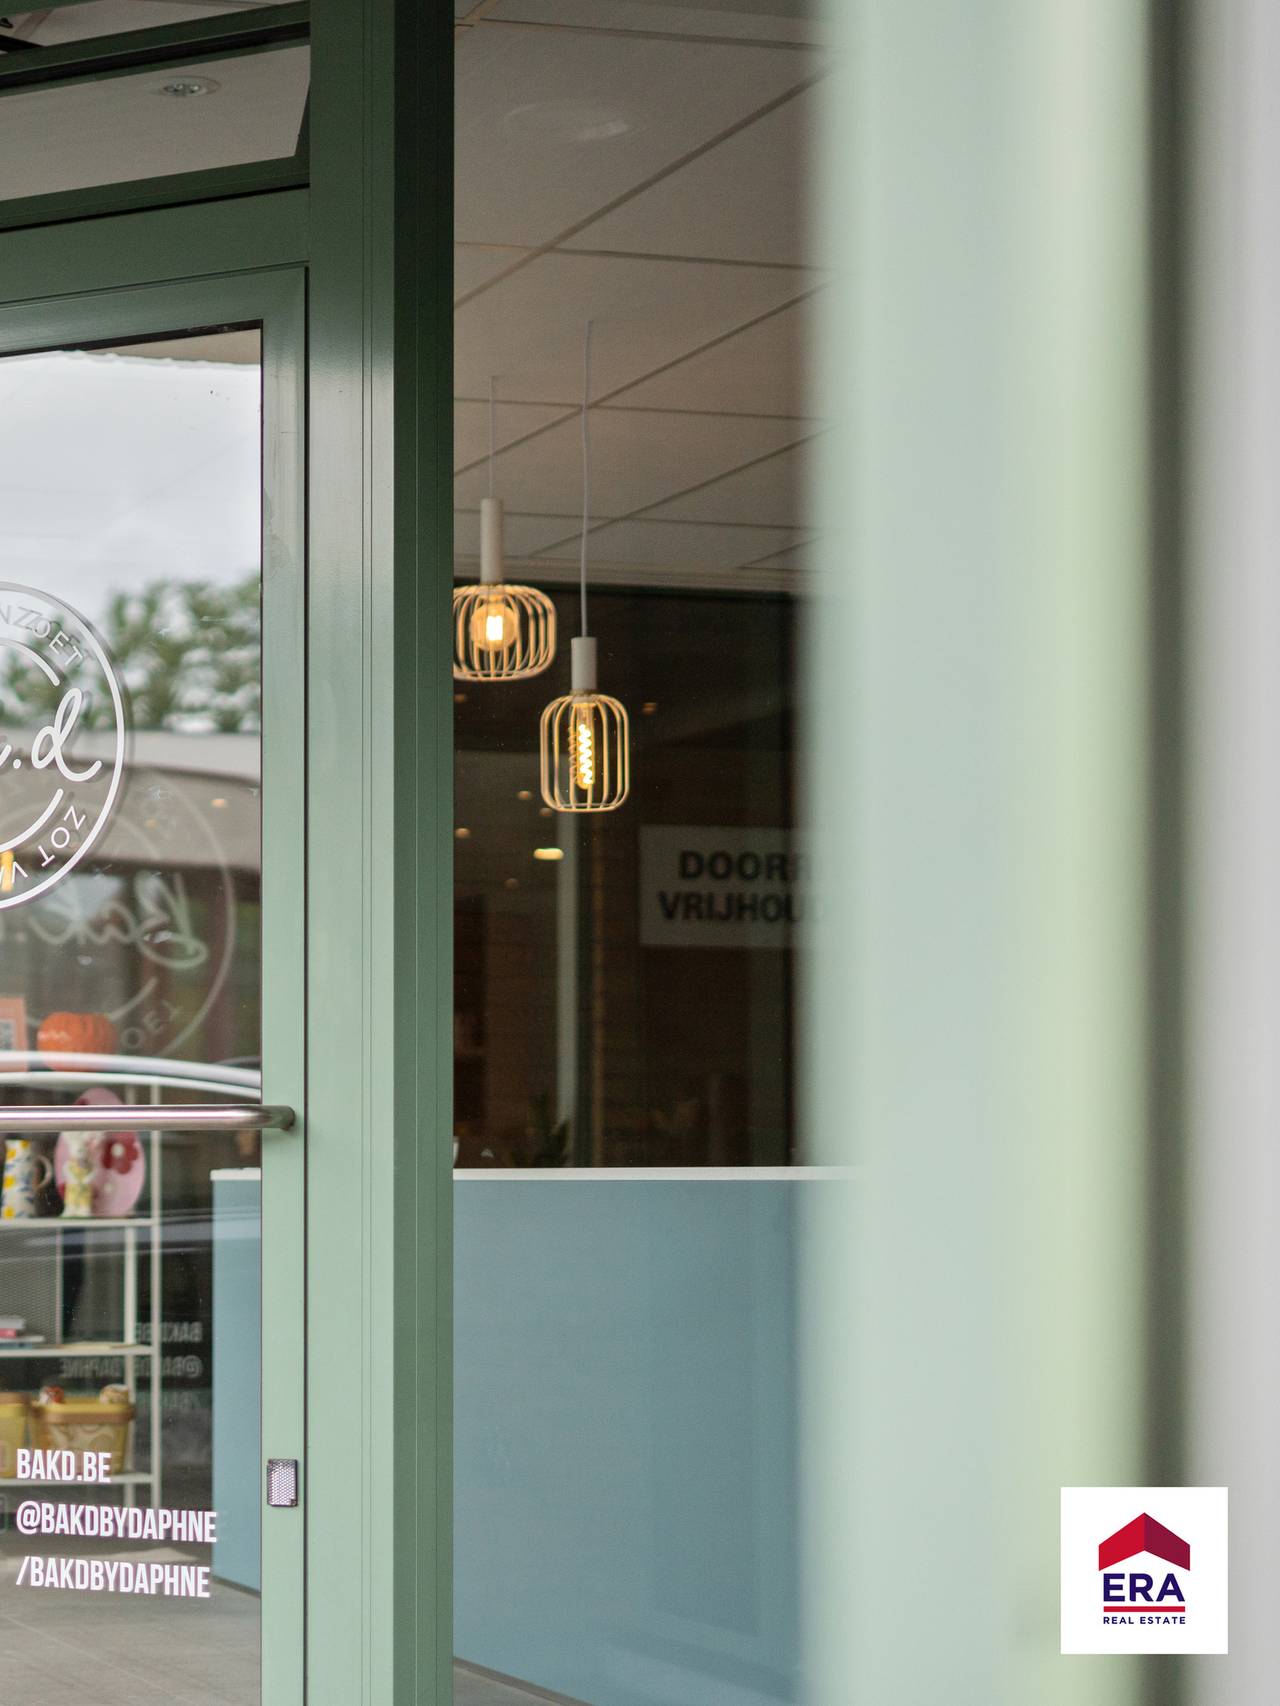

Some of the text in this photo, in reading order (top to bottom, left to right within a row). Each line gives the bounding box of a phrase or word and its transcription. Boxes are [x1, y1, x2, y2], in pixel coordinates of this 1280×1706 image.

[37, 804, 87, 868] ZOT
[17, 1448, 112, 1484] BAKD.BE
[16, 1500, 218, 1543] @BAKDBYDAPHNE
[16, 1556, 211, 1598] /BAKDBYDAPHNE
